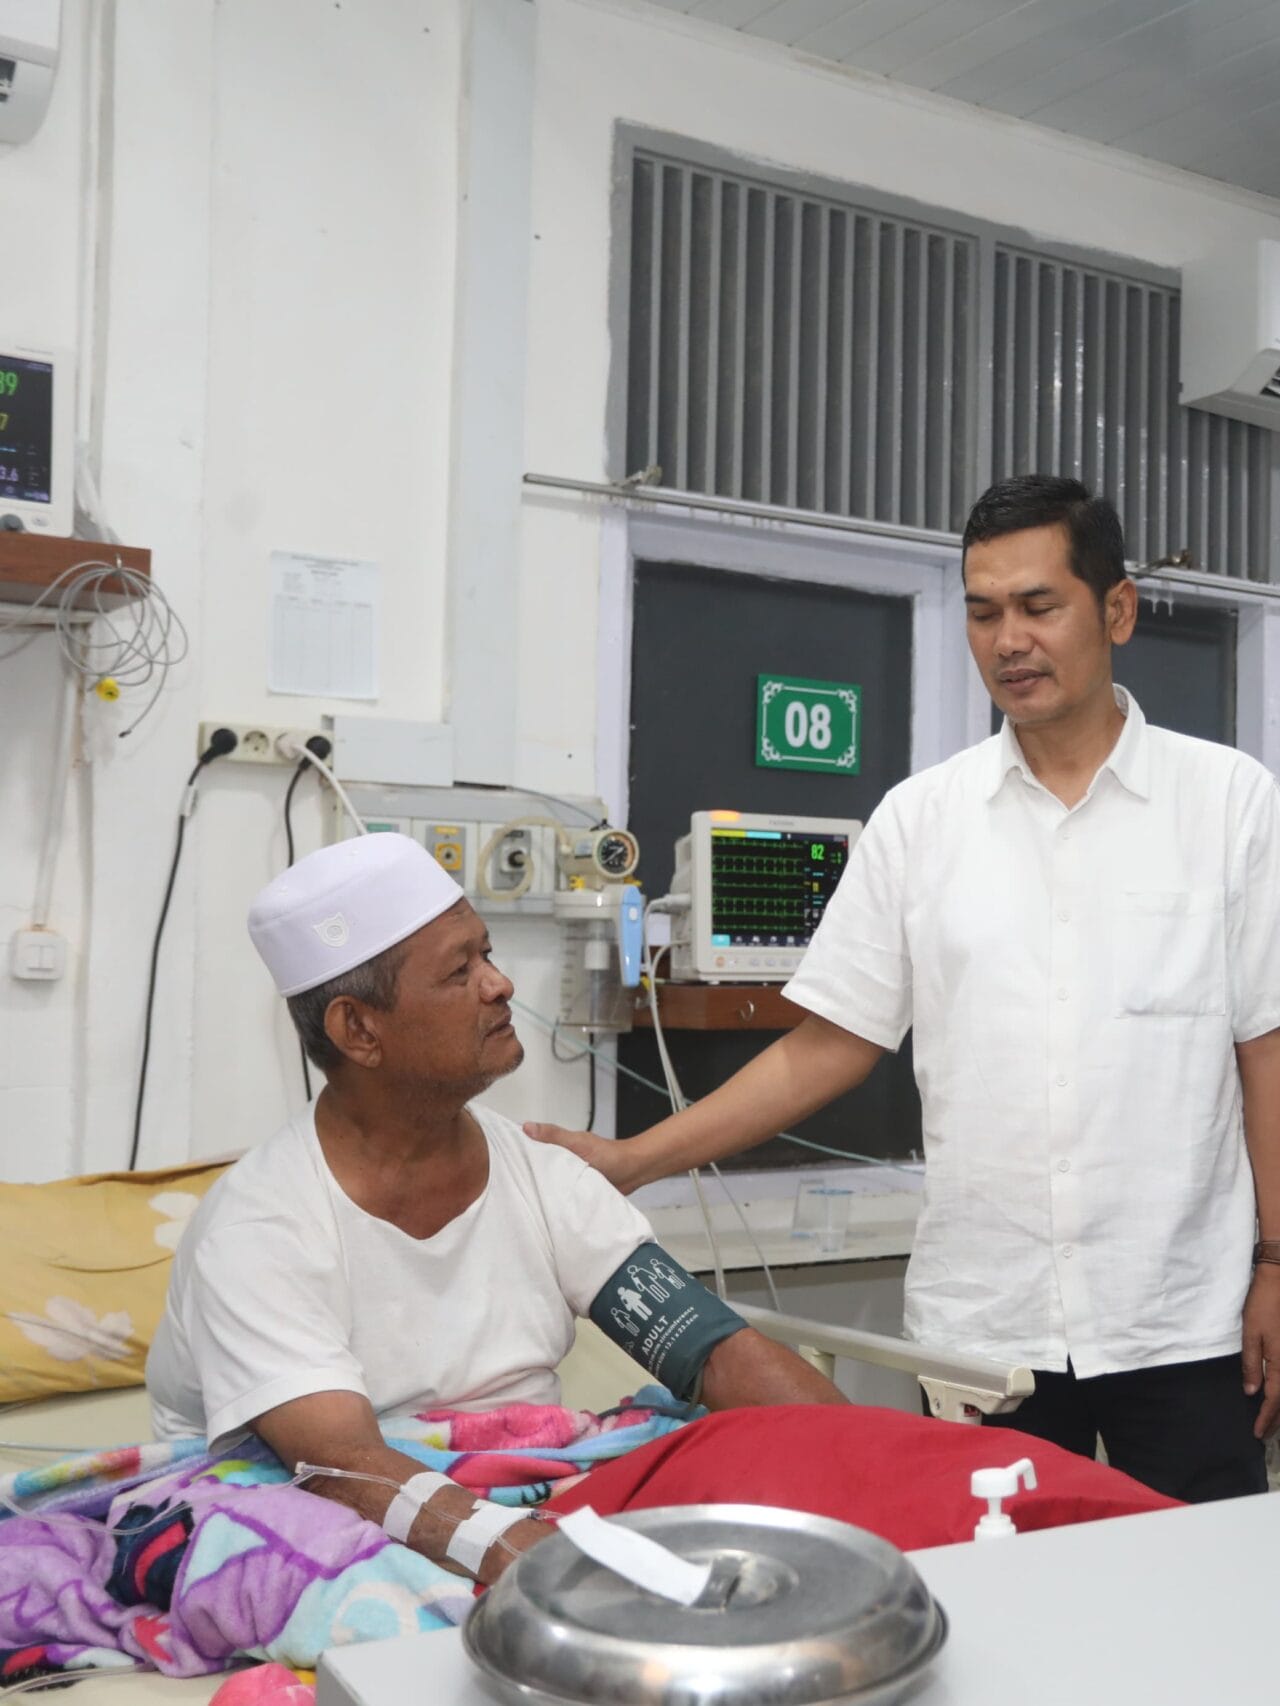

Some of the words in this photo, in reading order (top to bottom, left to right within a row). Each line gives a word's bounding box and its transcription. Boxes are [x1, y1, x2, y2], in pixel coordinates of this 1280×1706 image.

[785, 701, 832, 750] 08
[811, 844, 825, 861] 82
[641, 1315, 668, 1356] ADULT
